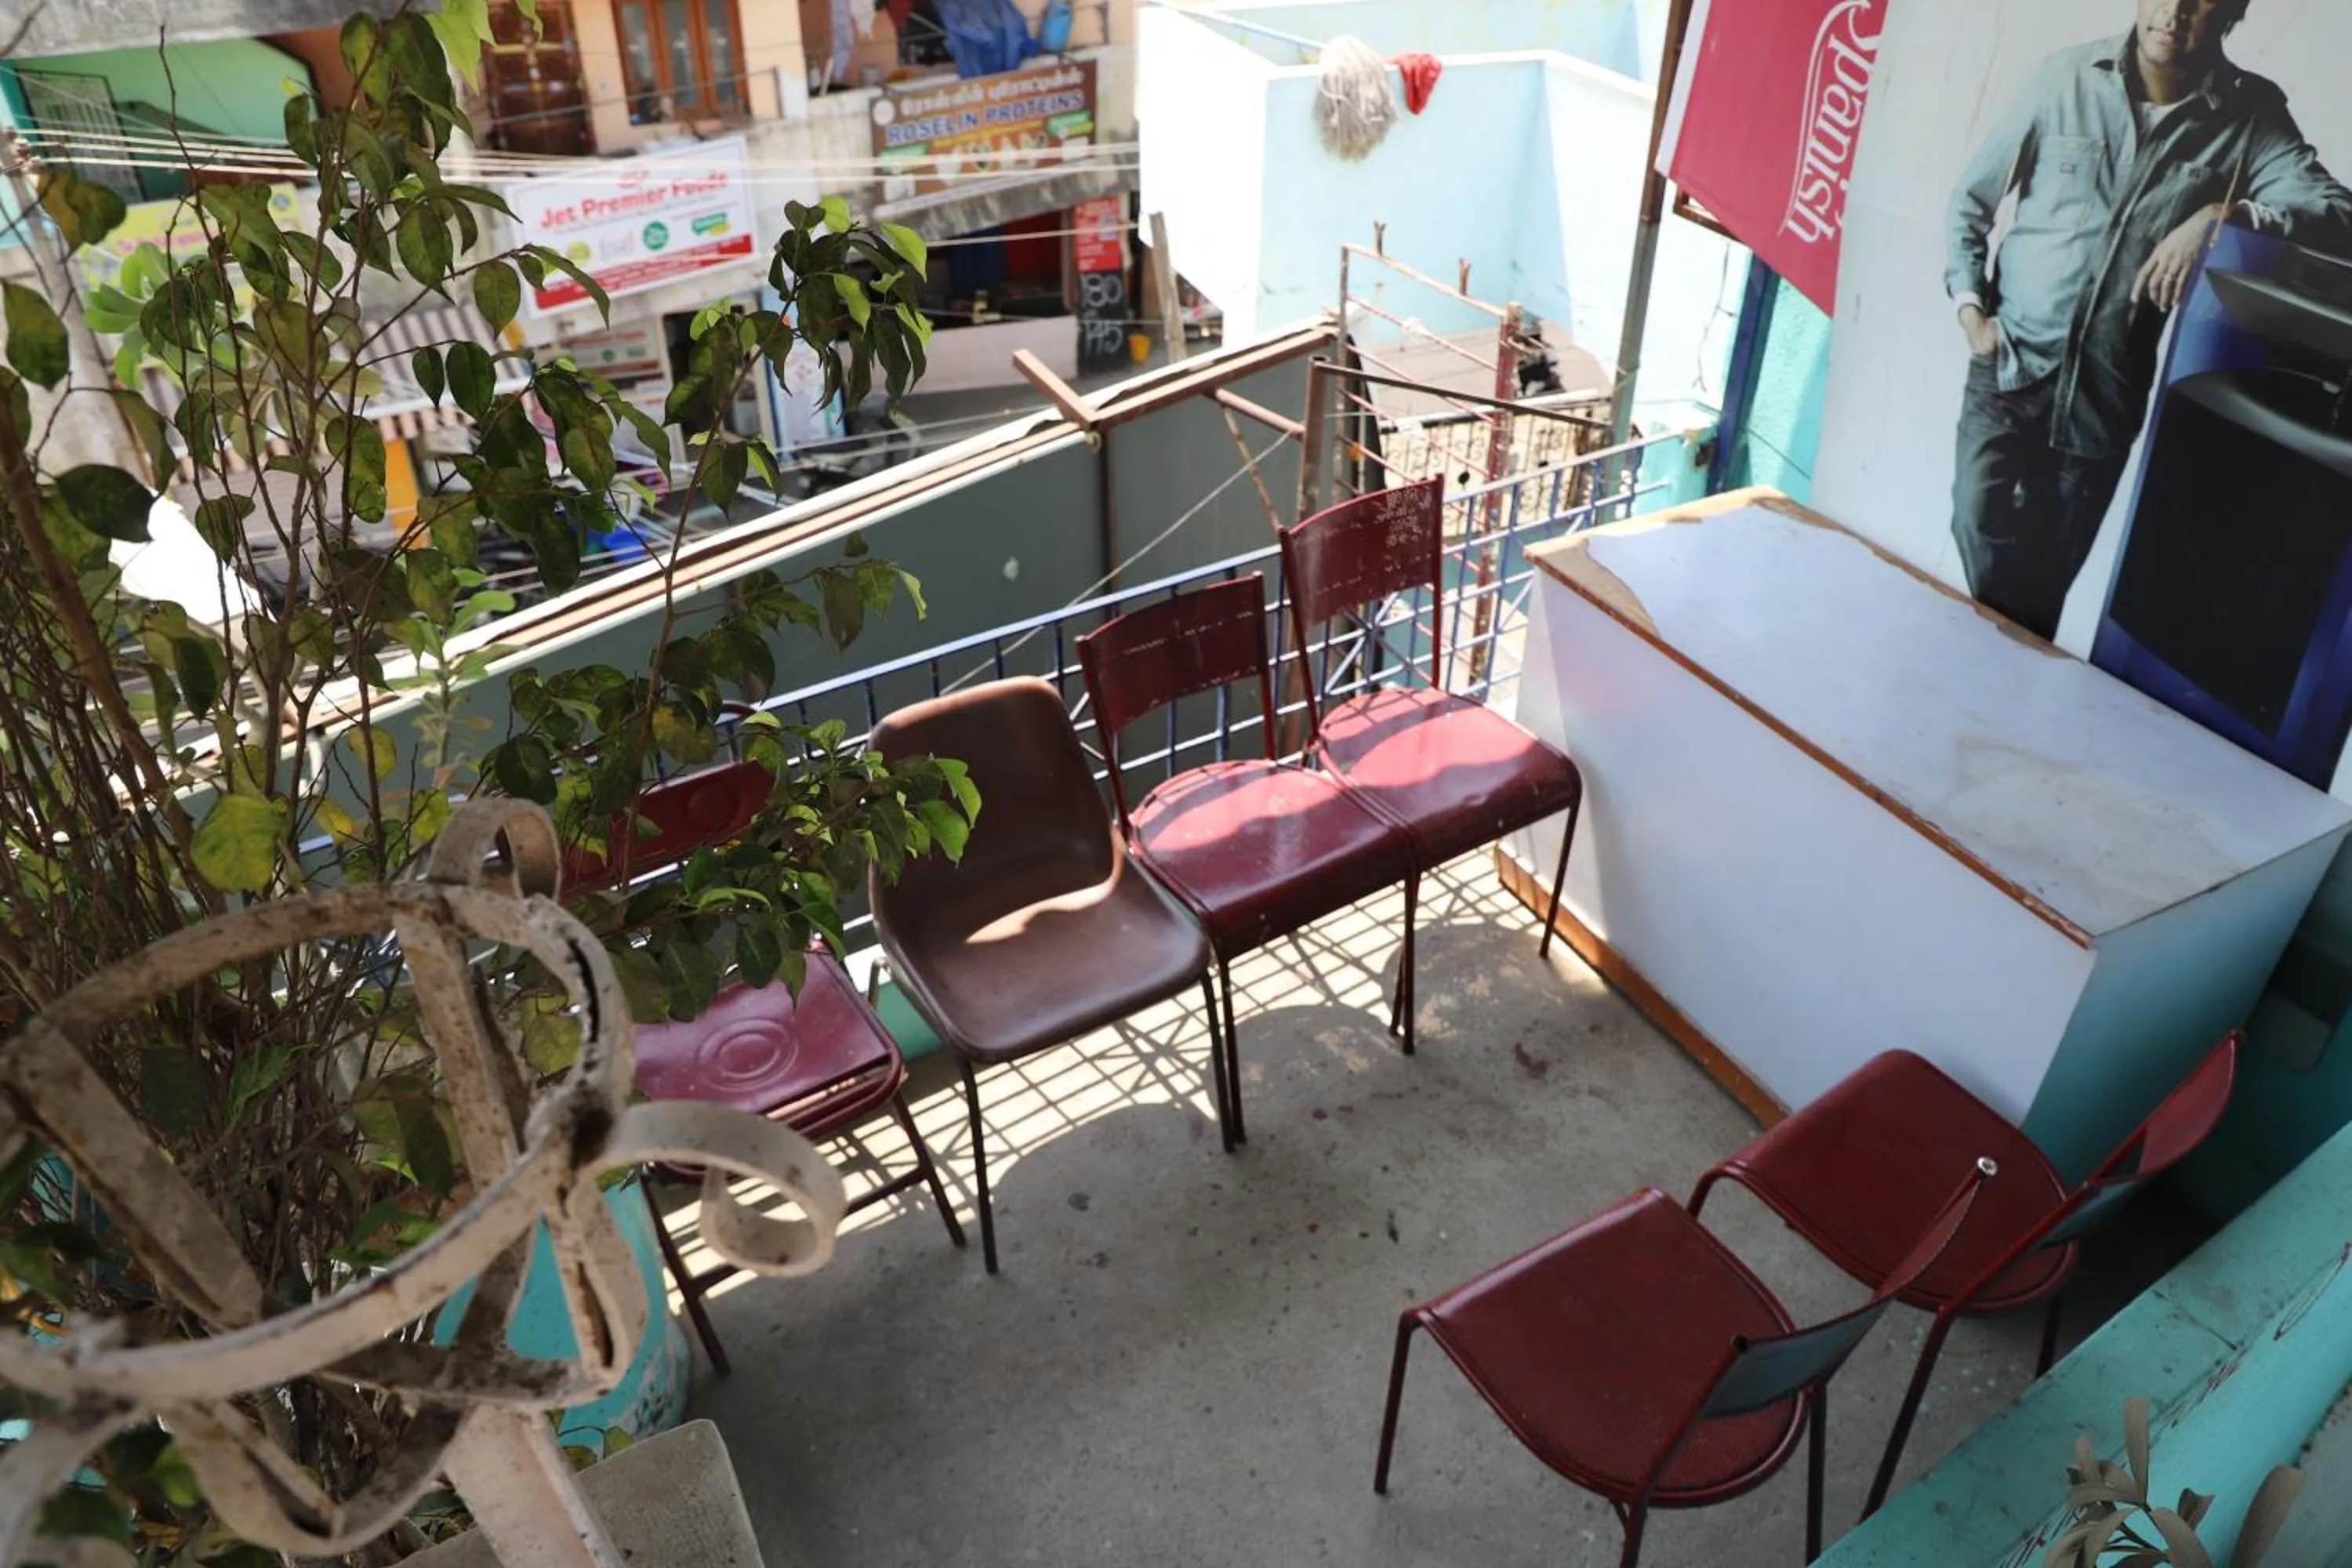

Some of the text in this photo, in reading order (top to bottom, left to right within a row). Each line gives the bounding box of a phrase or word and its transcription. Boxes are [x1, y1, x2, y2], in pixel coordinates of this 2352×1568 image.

[885, 111, 979, 146] ROSELIN
[983, 89, 1085, 124] PROTEINS
[540, 204, 576, 229] Jet
[581, 187, 667, 217] Premier
